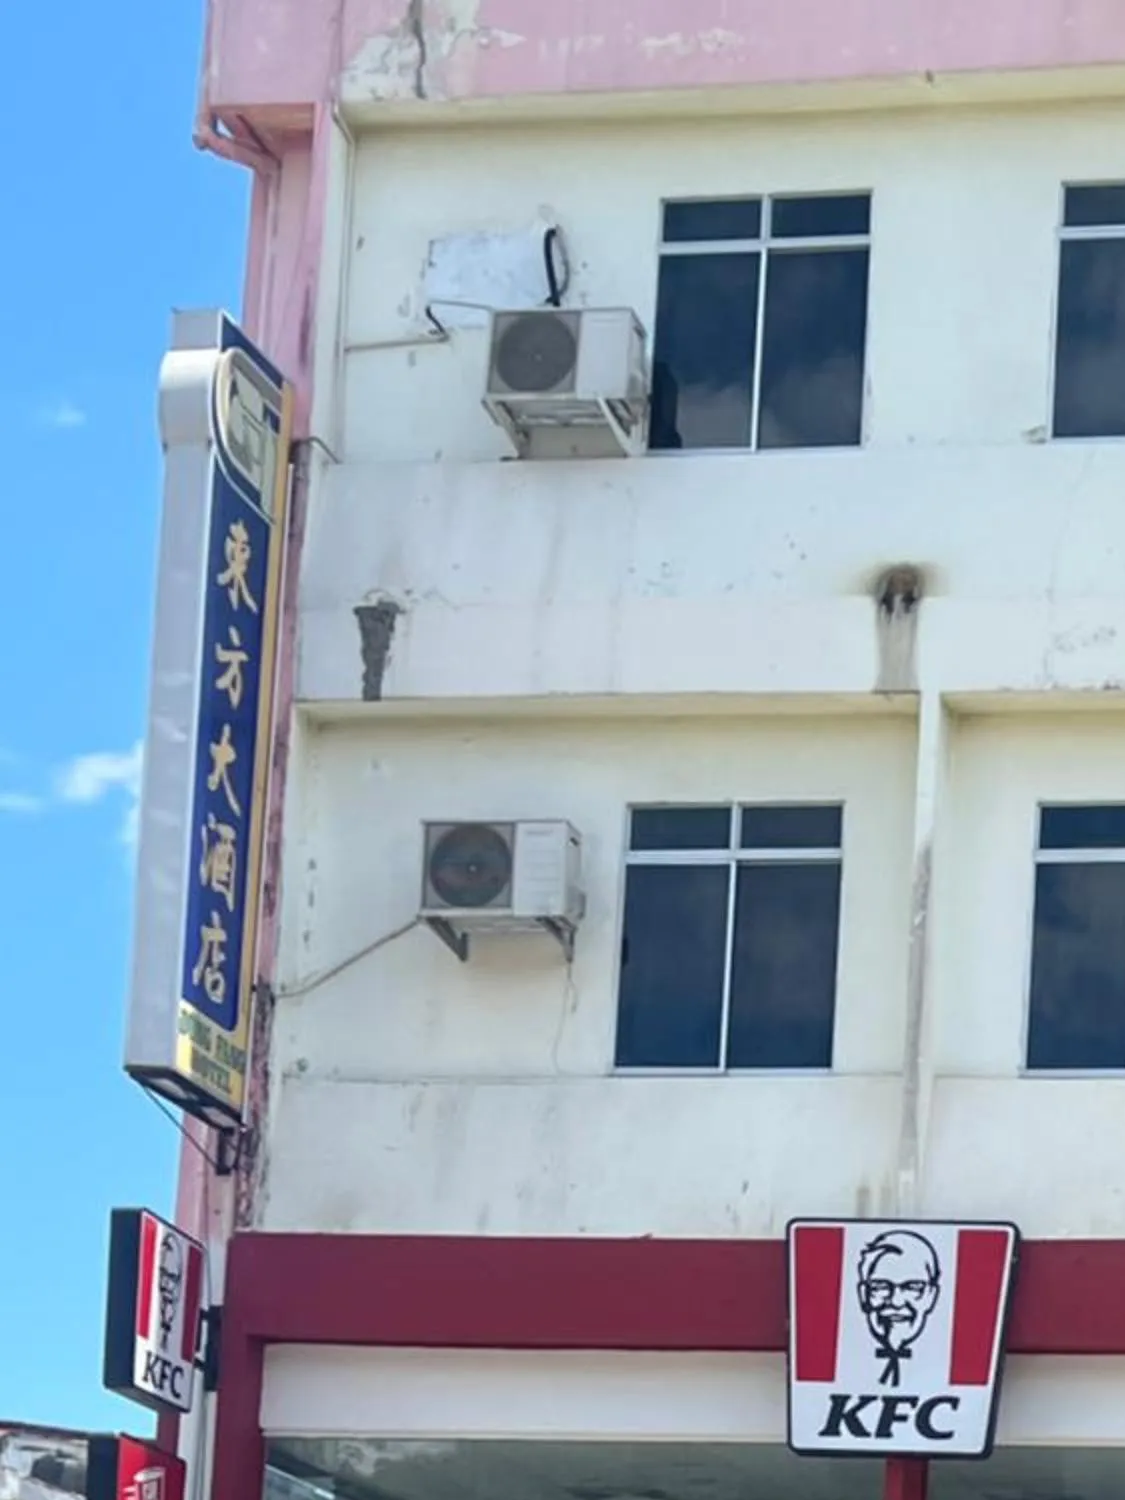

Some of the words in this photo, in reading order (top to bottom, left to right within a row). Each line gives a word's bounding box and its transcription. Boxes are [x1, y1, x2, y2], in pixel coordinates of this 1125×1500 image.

[193, 518, 258, 1004] 東方大酒店
[142, 1350, 185, 1400] KFC
[817, 1393, 961, 1441] KFC
